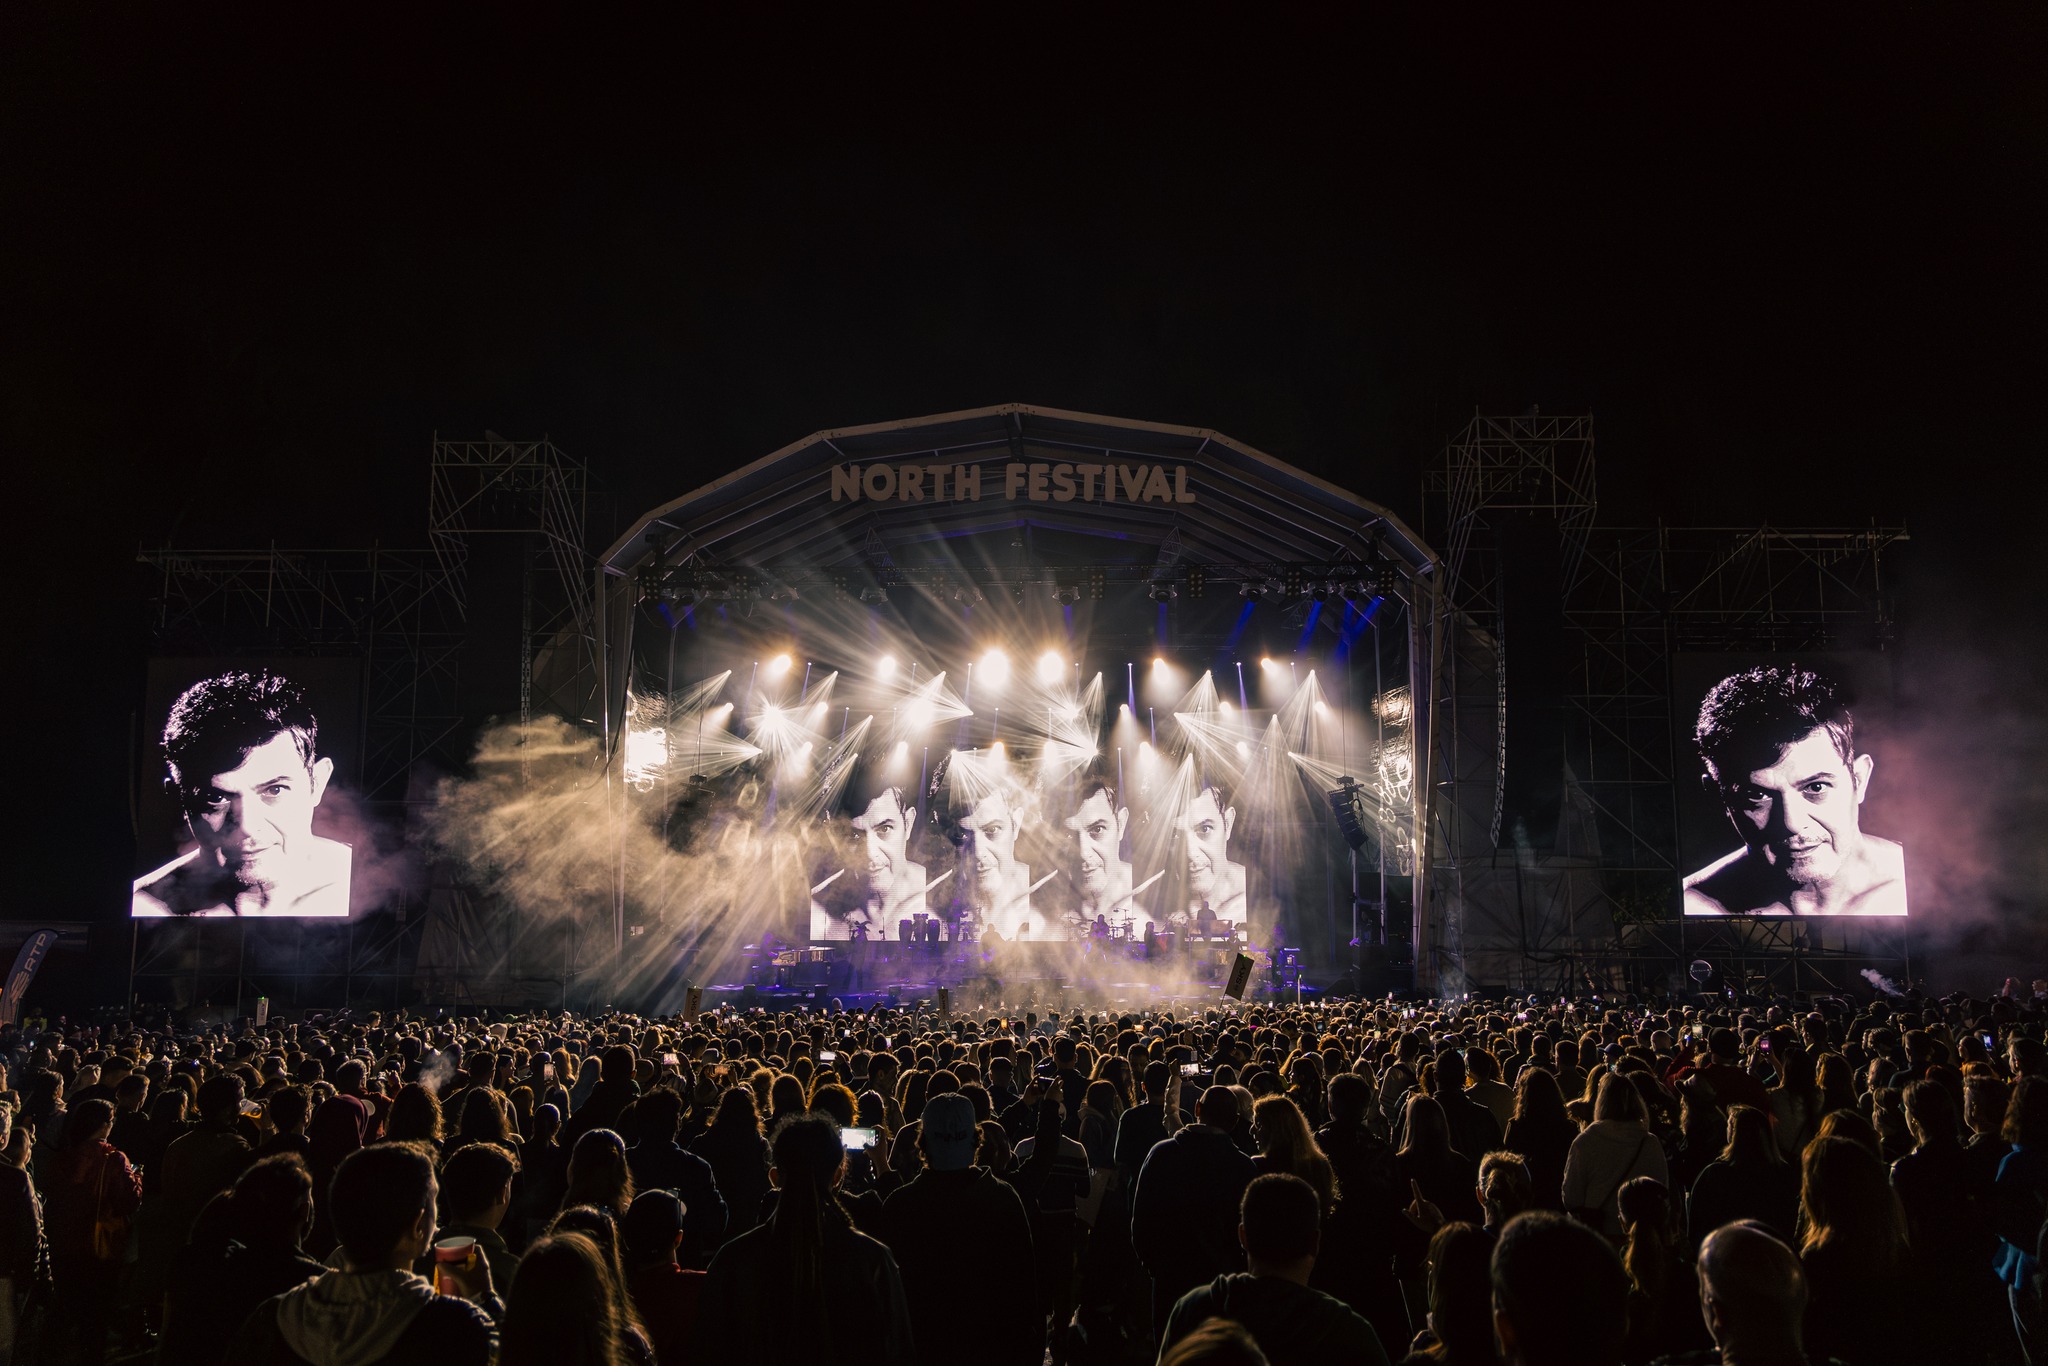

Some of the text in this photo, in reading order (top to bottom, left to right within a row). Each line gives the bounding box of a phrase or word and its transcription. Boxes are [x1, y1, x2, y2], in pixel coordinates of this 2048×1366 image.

[831, 463, 1196, 503] NORTH FESTIVAL
[24, 933, 46, 972] RTP
[1235, 961, 1247, 985] SKY
